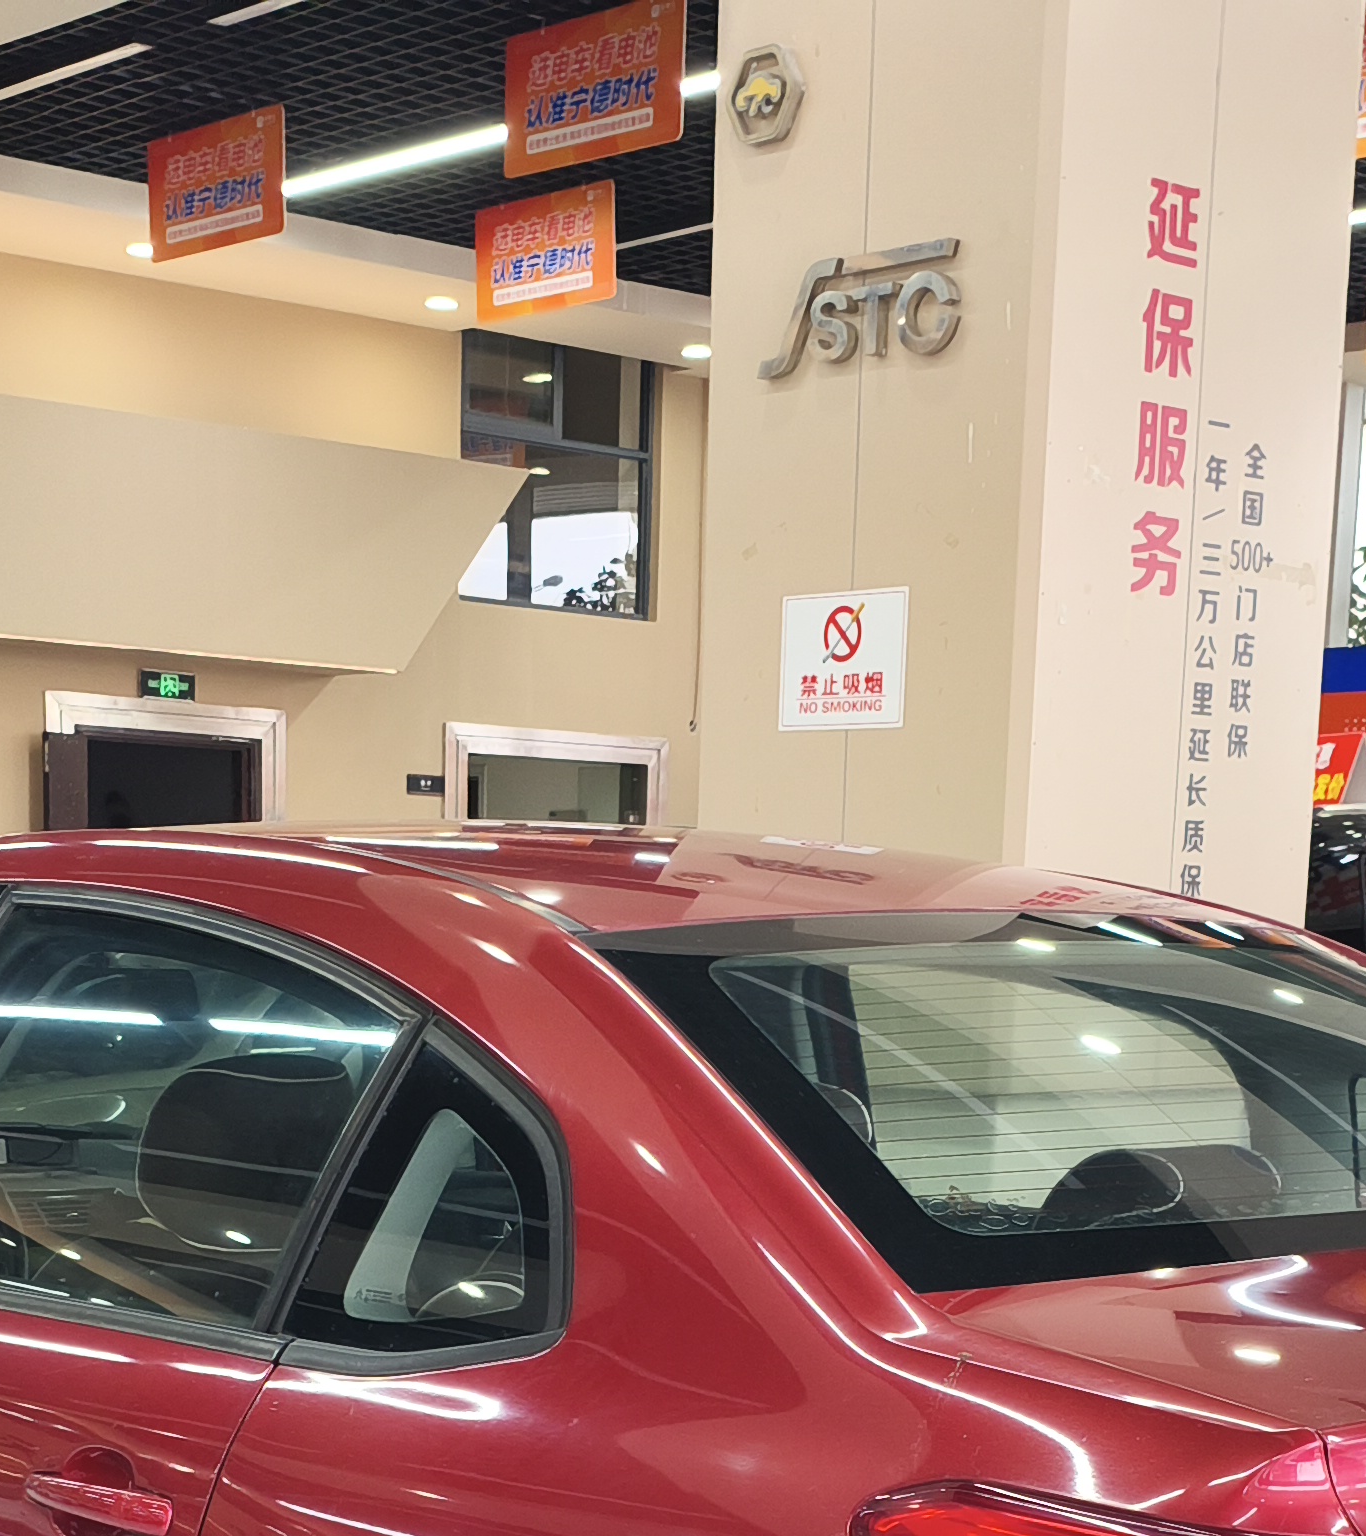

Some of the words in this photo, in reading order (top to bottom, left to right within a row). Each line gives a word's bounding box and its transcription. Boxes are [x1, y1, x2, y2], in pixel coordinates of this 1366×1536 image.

[527, 42, 594, 92] 选电车
[595, 23, 661, 75] 看电池
[526, 67, 658, 131] 认准宁德时代
[164, 169, 266, 225] 认准宁德时代
[545, 205, 595, 242] 看电池
[491, 239, 595, 287] 认准宁德时代
[1131, 177, 1201, 597] 延保服务
[799, 702, 818, 714] NO
[822, 699, 883, 713] SMOKING
[800, 671, 883, 698] 禁止吸烟
